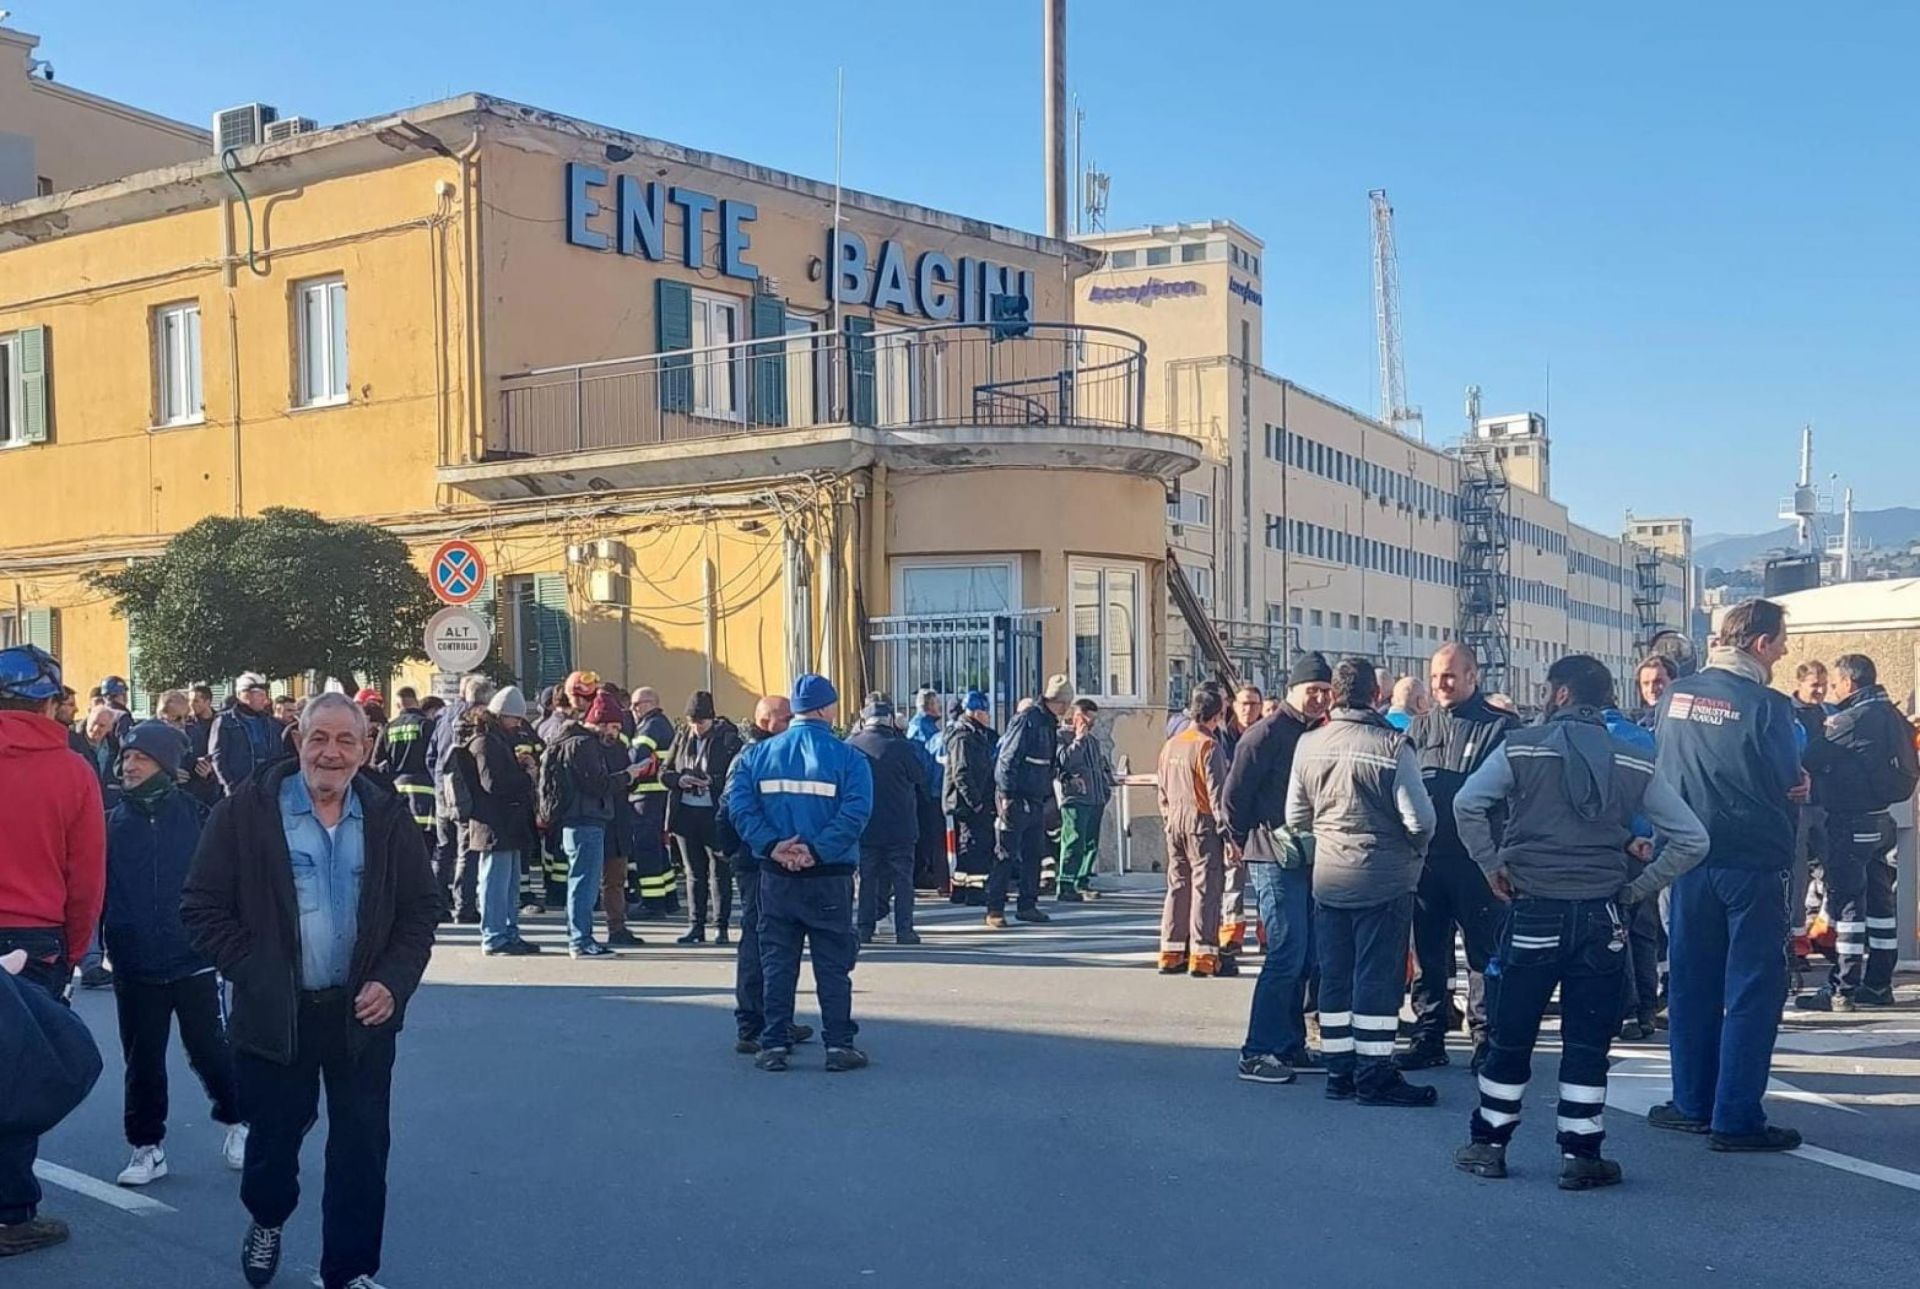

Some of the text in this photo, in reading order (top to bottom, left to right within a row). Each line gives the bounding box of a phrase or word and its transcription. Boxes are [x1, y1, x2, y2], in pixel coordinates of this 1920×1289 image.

[565, 161, 1035, 338] ENTE BACINI
[445, 626, 470, 637] ALT
[437, 642, 478, 651] CONTROLLO
[1692, 704, 1741, 721] INDUSTRIE
